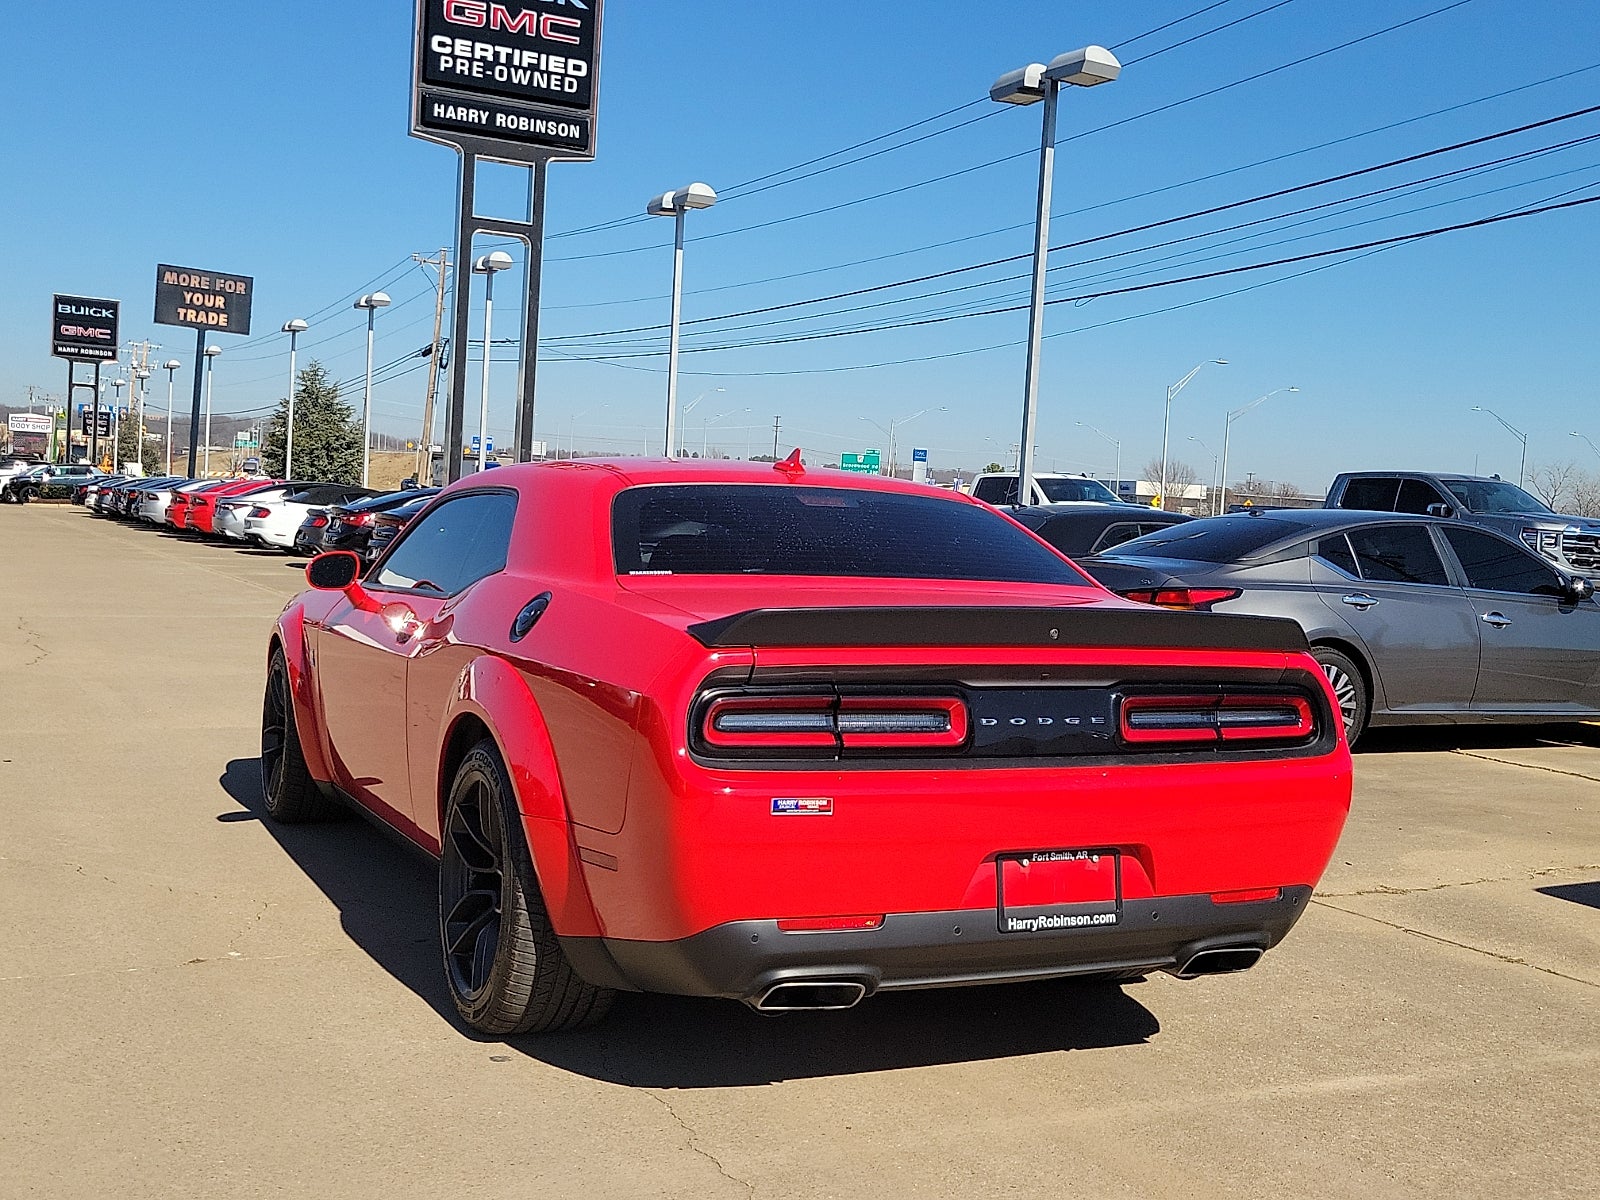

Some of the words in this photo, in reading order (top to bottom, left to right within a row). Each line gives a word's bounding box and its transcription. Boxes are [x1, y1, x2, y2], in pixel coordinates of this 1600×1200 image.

[443, 0, 581, 45] GMC
[431, 35, 588, 77] CERTIFIED
[440, 55, 578, 93] PRE-OWNED
[433, 103, 489, 124] HARRY
[495, 113, 580, 139] ROBINSON
[163, 271, 210, 289] MORE
[215, 278, 246, 294] FOR
[183, 291, 225, 309] YOUR
[58, 303, 114, 318] BUICK
[177, 308, 228, 326] TRADE
[60, 324, 111, 339] GMC
[80, 348, 113, 356] ROBINSON
[31, 423, 51, 431] SHOP
[980, 717, 1105, 726] DODGE
[1032, 852, 1049, 862] Fort
[1050, 851, 1075, 862] Smith,
[1075, 850, 1089, 860] AR
[1007, 913, 1117, 932] HarryRobinson.com
